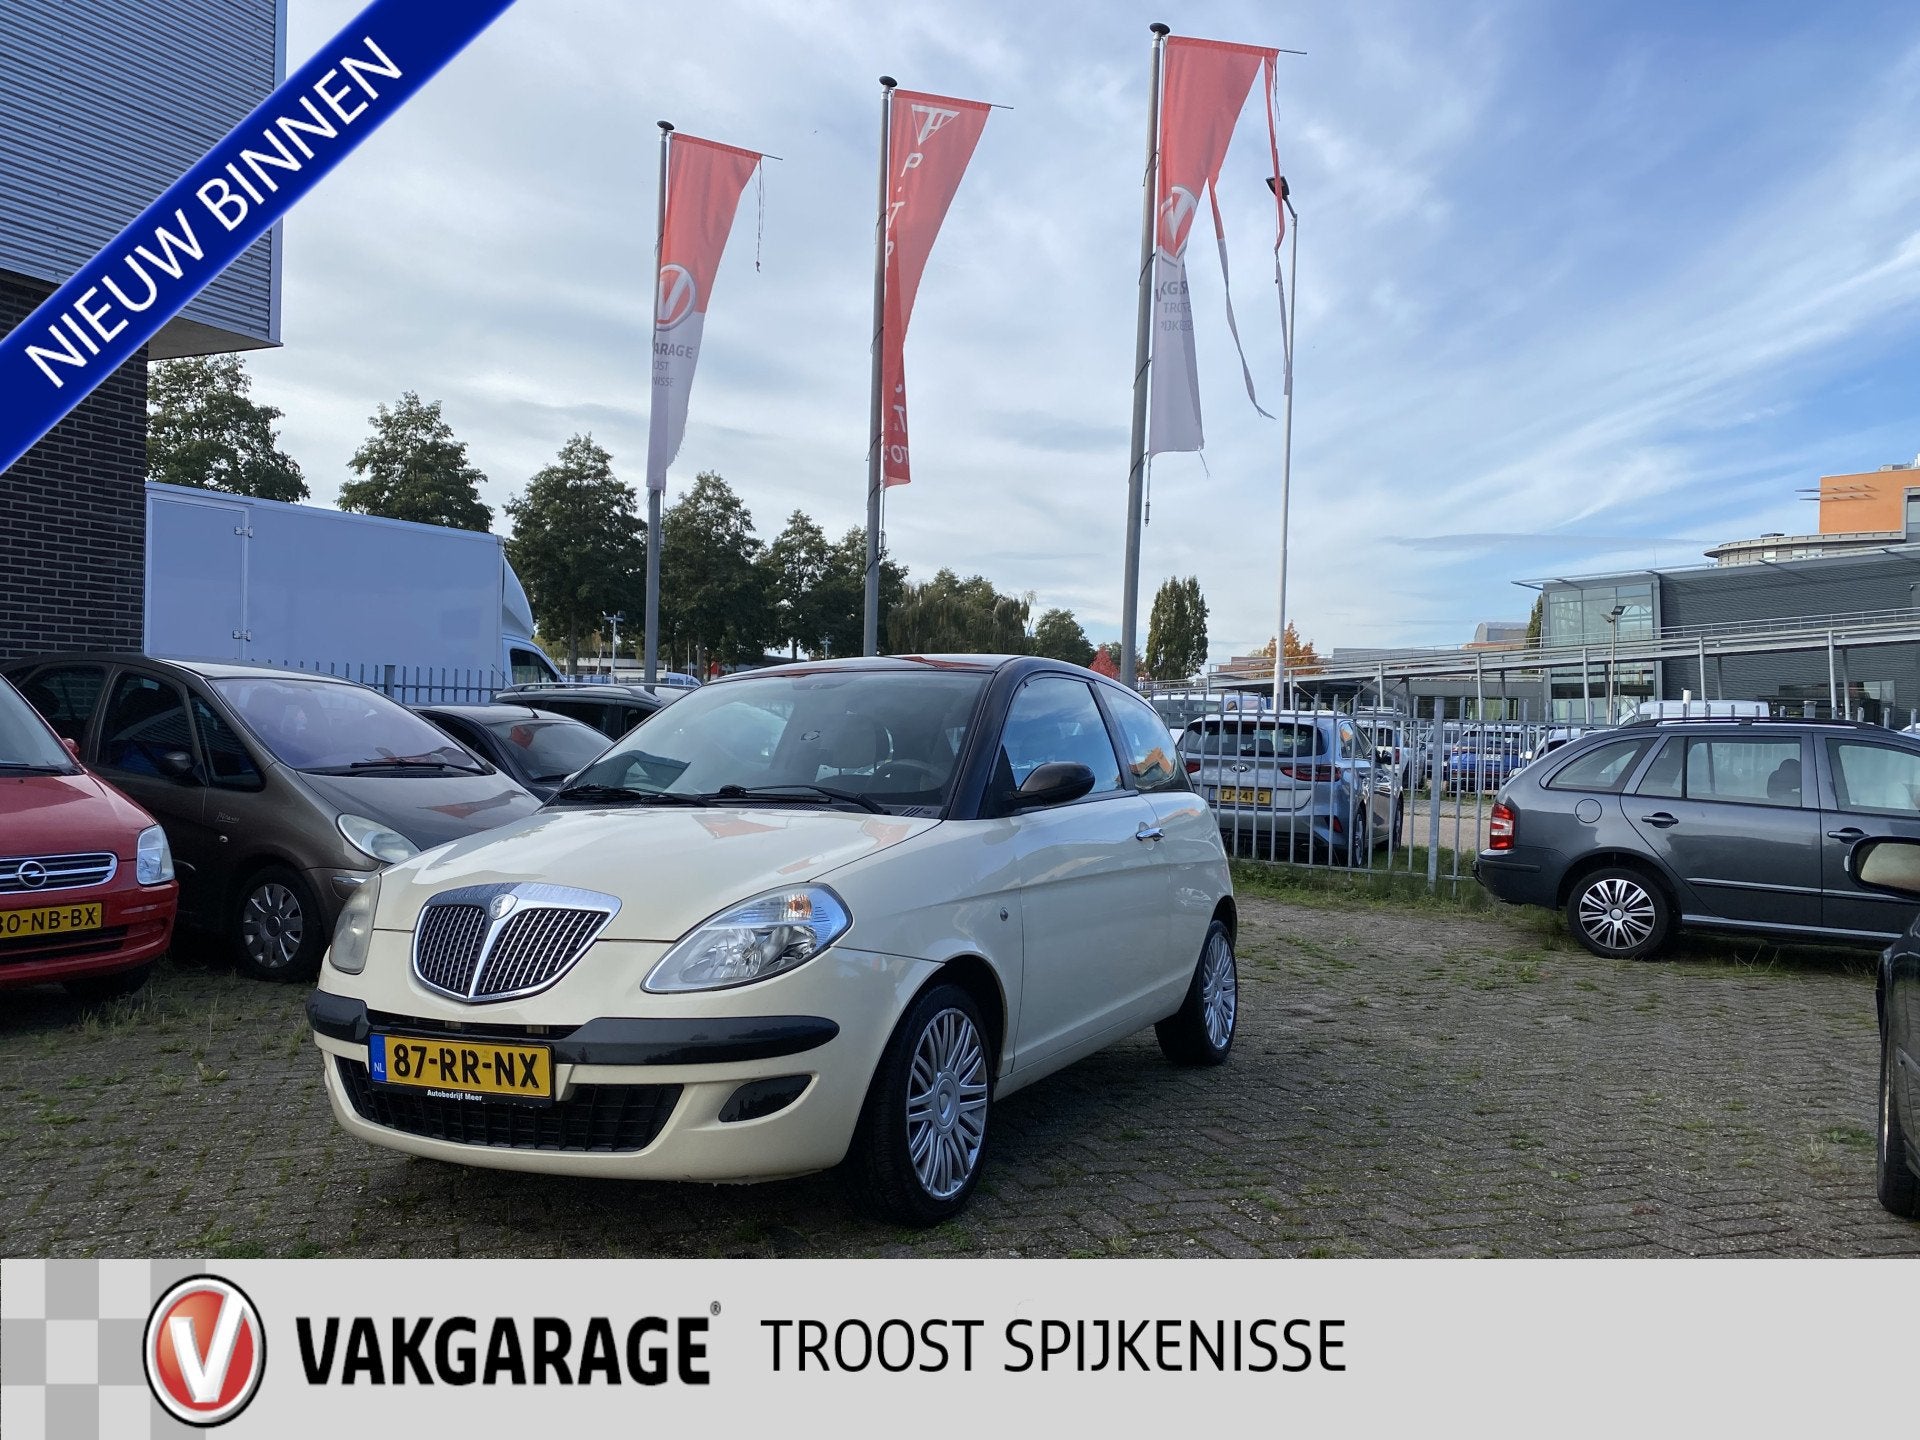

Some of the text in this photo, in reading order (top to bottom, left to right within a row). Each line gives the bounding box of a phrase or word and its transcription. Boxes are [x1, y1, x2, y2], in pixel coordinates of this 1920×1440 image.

[374, 1043, 539, 1088] NL 87-RR-NX
[427, 1089, 483, 1101] Autobedrijf Meer
